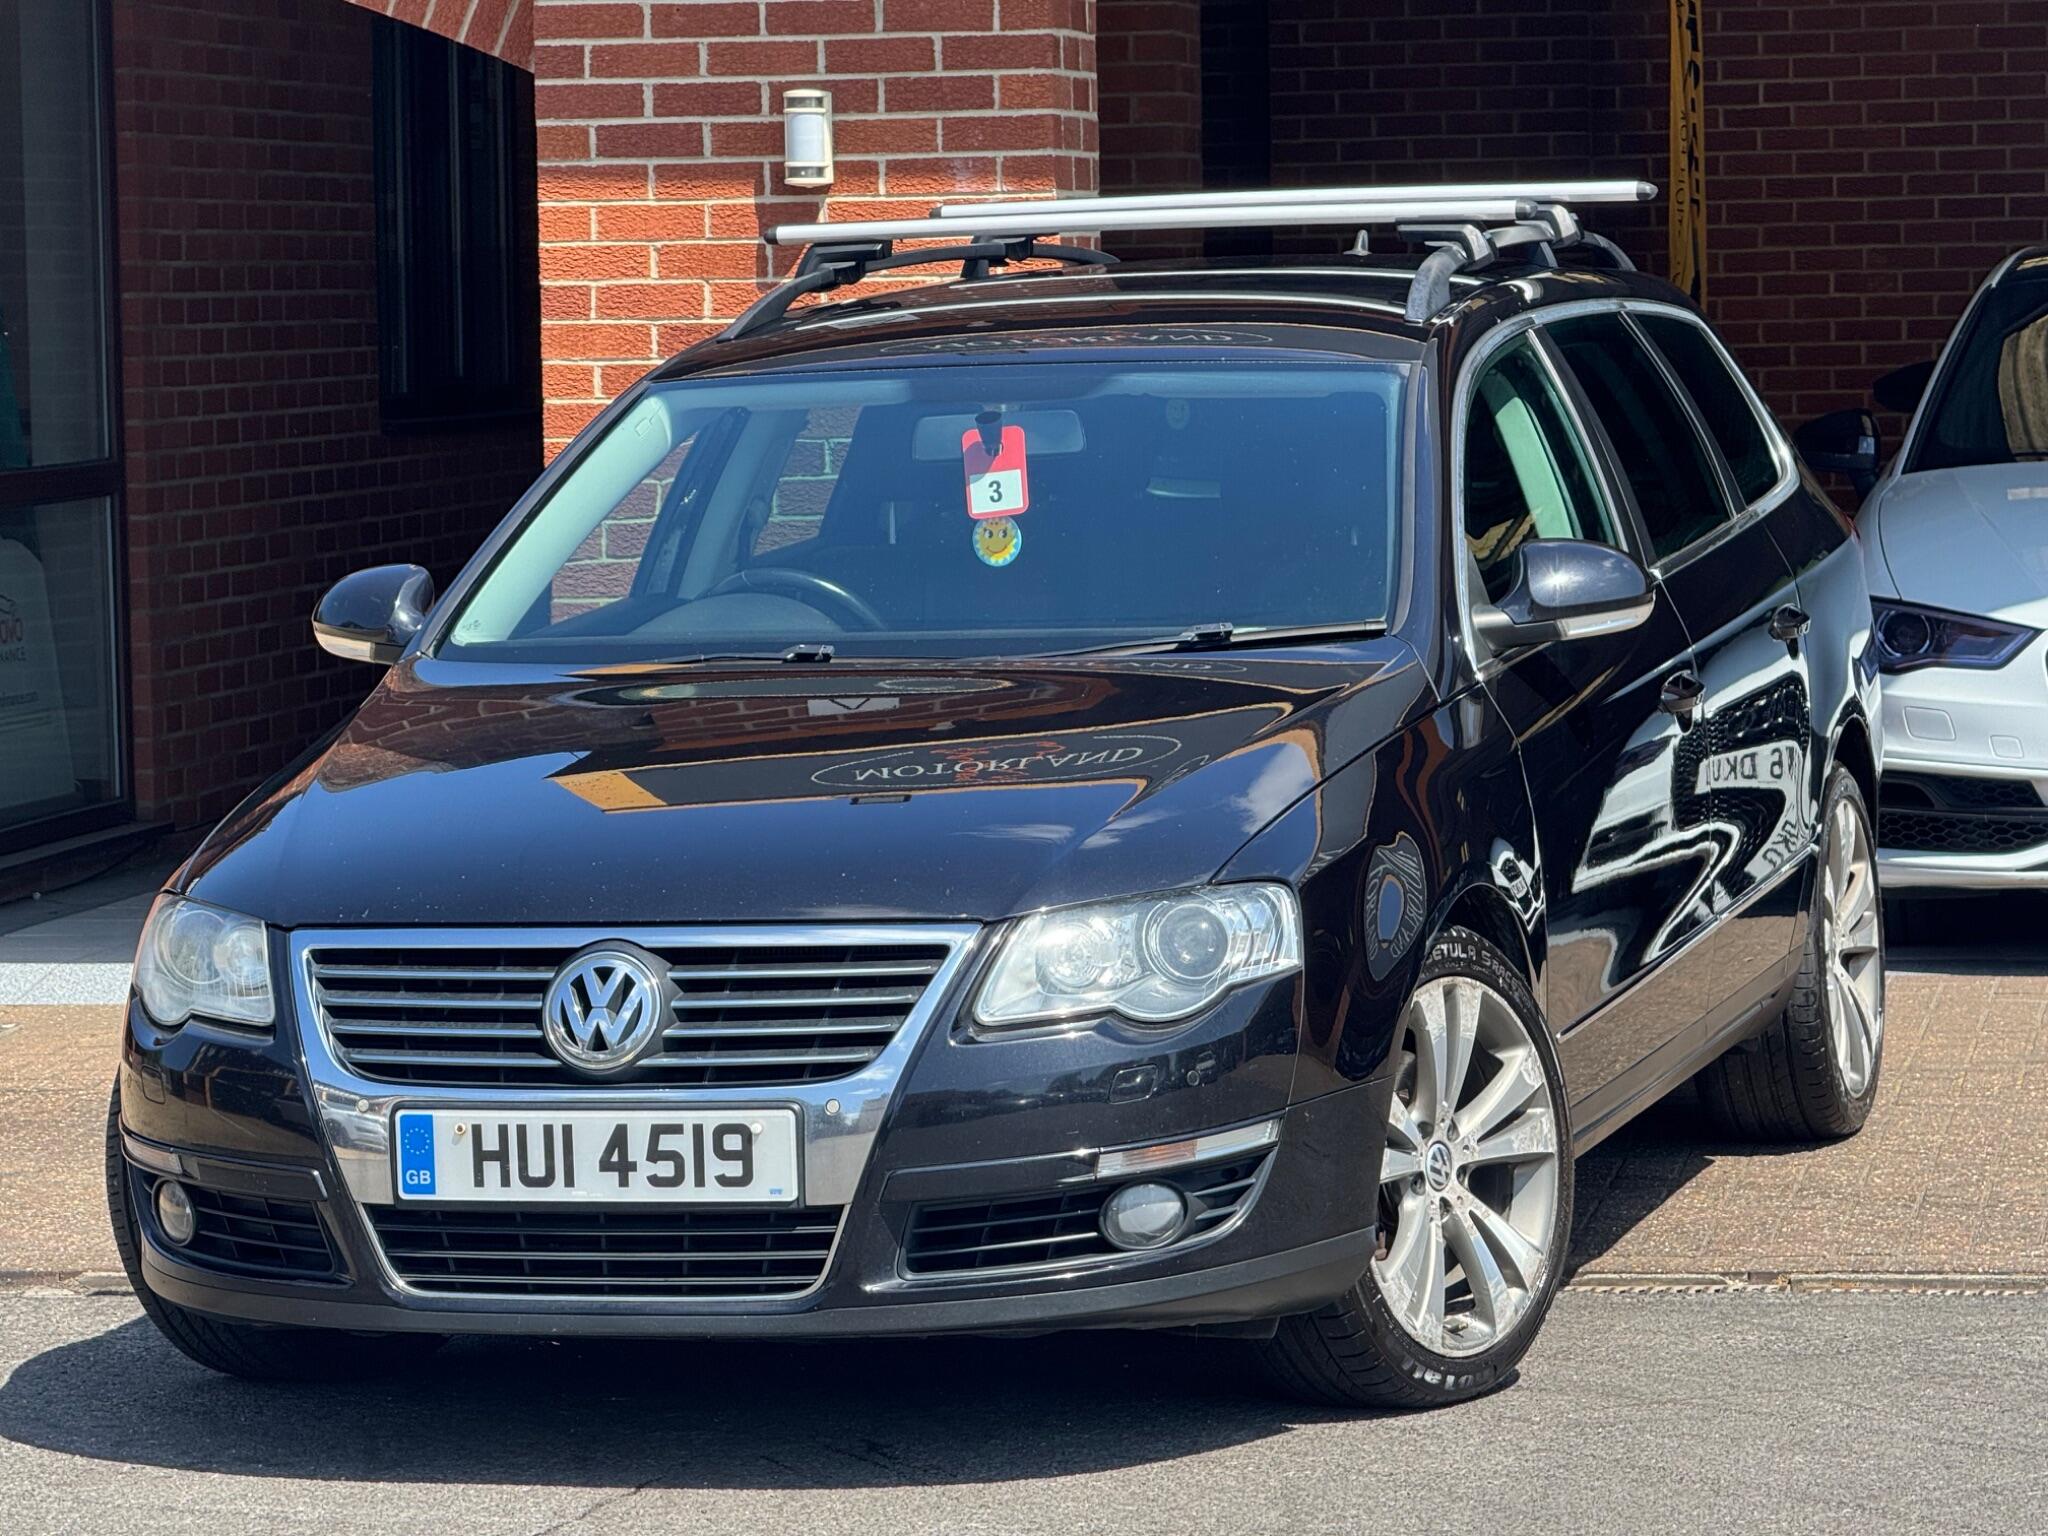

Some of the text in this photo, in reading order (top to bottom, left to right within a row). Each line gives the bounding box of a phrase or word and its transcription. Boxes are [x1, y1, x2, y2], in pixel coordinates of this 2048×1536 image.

[988, 480, 1003, 503] 3
[546, 951, 660, 1069] VW
[405, 1169, 431, 1185] GB
[471, 1122, 754, 1189] HUI 4519
